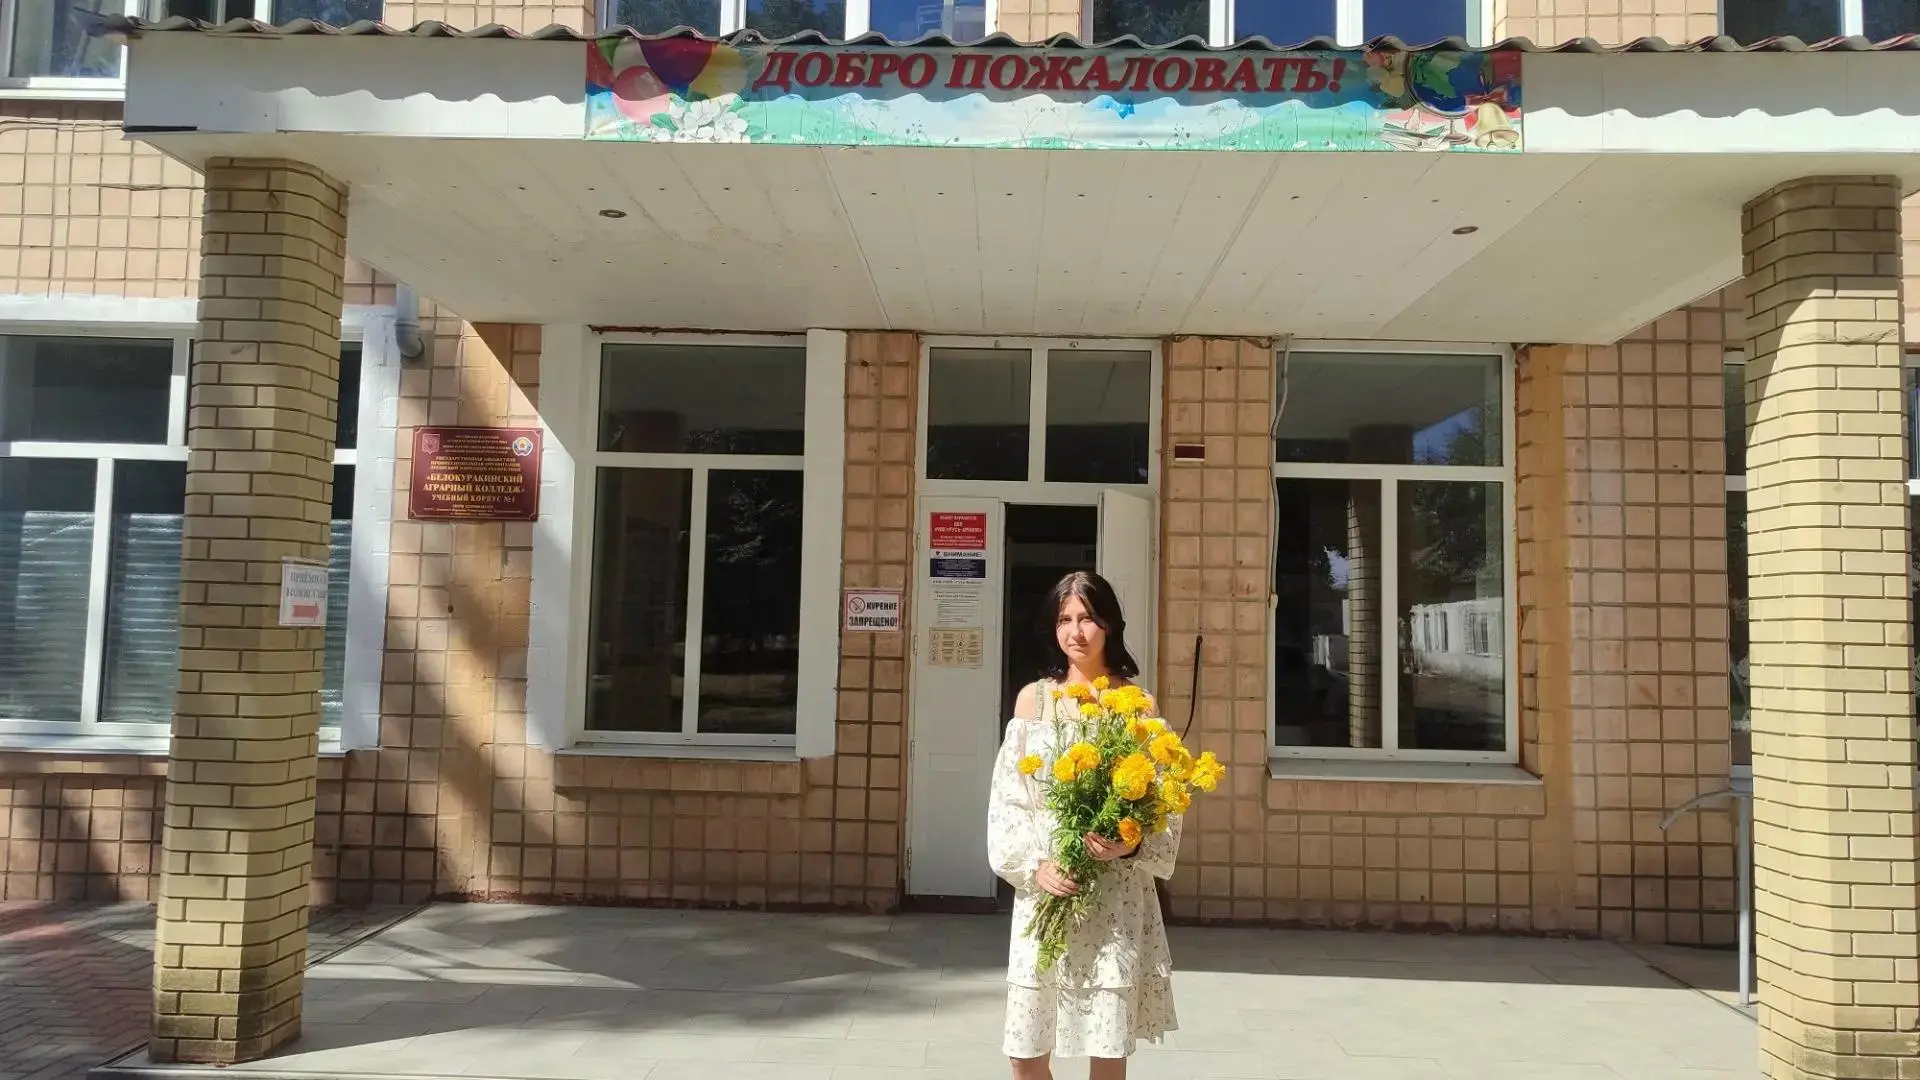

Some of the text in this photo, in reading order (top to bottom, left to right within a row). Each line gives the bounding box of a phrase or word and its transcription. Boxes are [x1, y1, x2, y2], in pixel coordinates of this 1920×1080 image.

[751, 51, 1347, 93] ДОБРО ПОЖАЛОВАТЬ!
[426, 473, 523, 483] «БЕЛОКУРАКИНСКИЙ
[423, 483, 525, 493] АГРАРНЫЙ КОЛЛЕДЖ»
[432, 493, 469, 501] УЧЕБНЫЙ
[866, 601, 898, 611] КУРЕНИЕ
[848, 616, 898, 628] ЗАПРЕЩЕНО!
